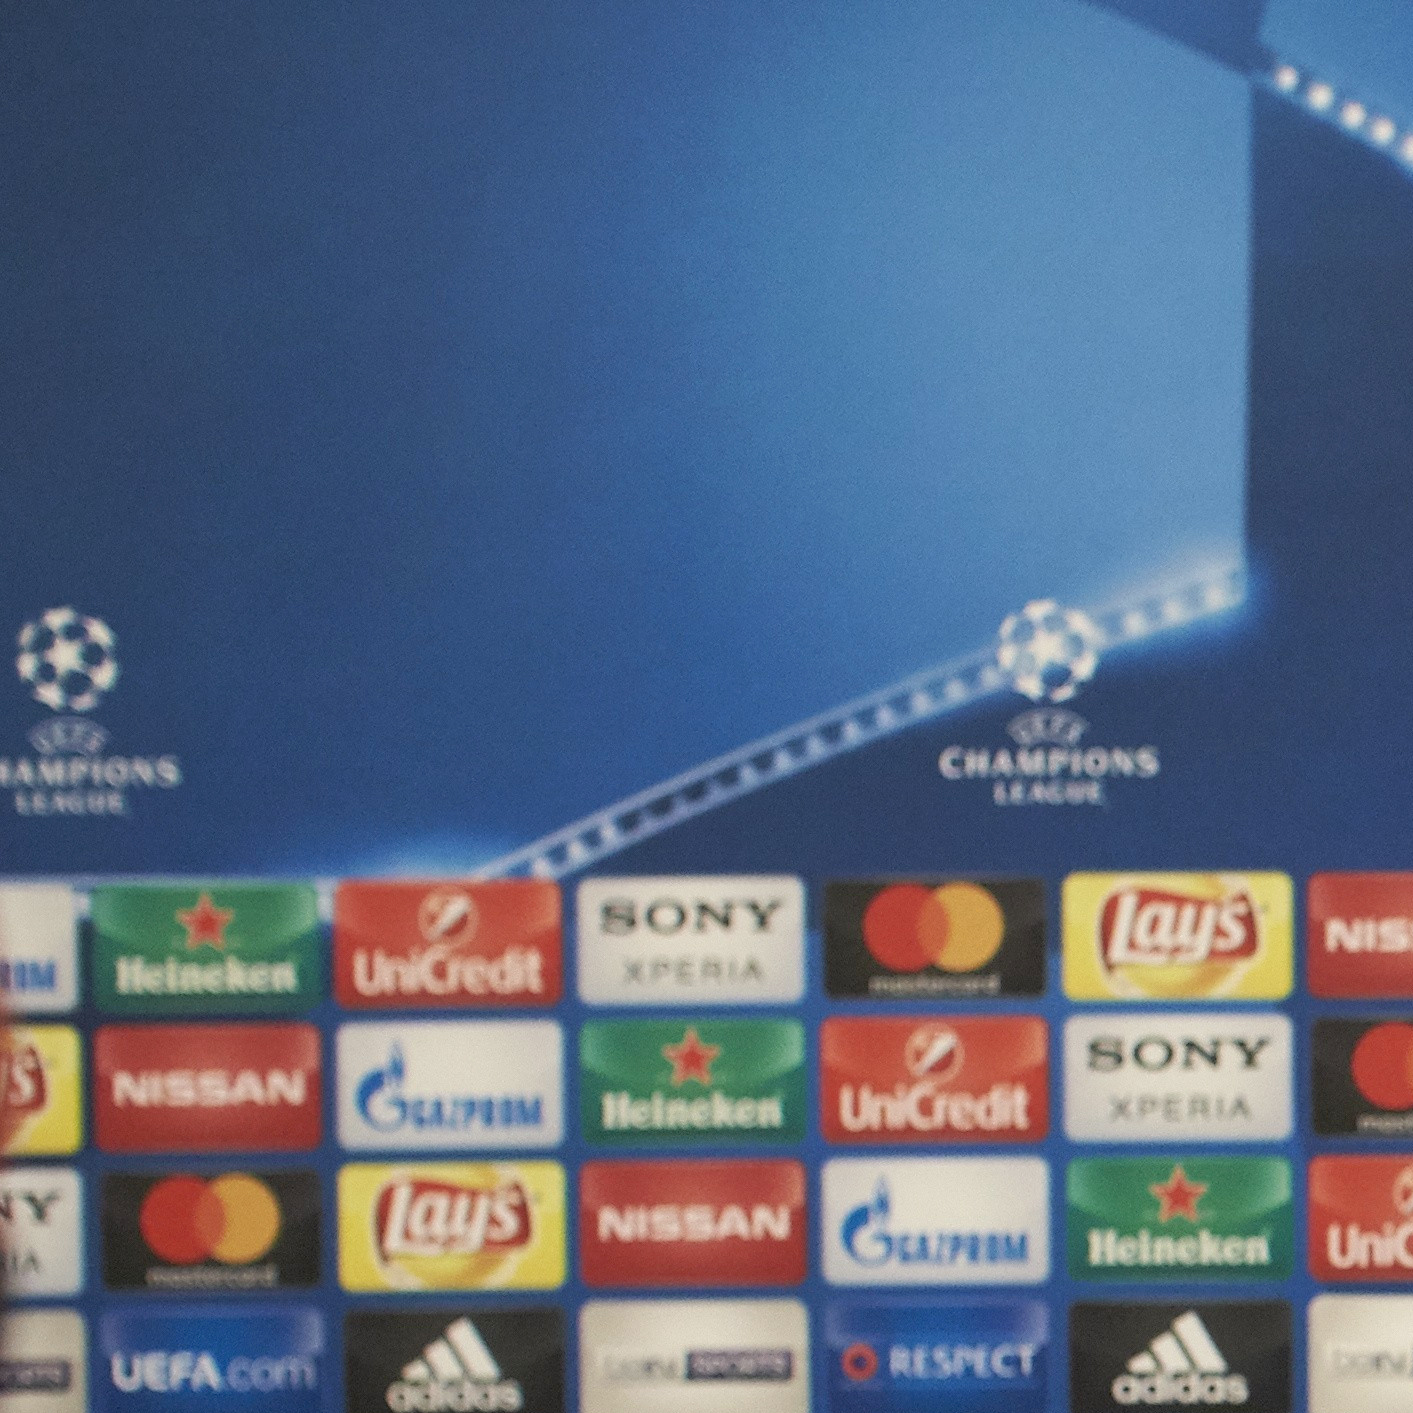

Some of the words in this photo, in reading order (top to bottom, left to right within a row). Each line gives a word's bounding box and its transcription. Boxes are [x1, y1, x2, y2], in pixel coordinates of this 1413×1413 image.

[0, 755, 182, 788] AMPIONS
[938, 746, 1160, 780] CHAMPIONS
[600, 898, 782, 936] SONY
[115, 957, 297, 996] Heineken
[353, 946, 543, 996] UniCredit
[624, 956, 764, 986] XPERIA
[1087, 1035, 1270, 1073] SONY
[111, 1068, 305, 1108] NISSAN
[400, 1097, 544, 1131] GAZPROM
[602, 1091, 786, 1131] Heineken
[838, 1083, 1031, 1133] UniCredit
[1109, 1093, 1253, 1123] XPERIA
[599, 1203, 793, 1244] NISSAN
[892, 1231, 1029, 1267] GAZPROM
[1087, 1229, 1270, 1268] Heineken
[111, 1351, 317, 1393] UEFA.com
[889, 1342, 1036, 1380] RESPECT
[1112, 1372, 1249, 1405] adidas
